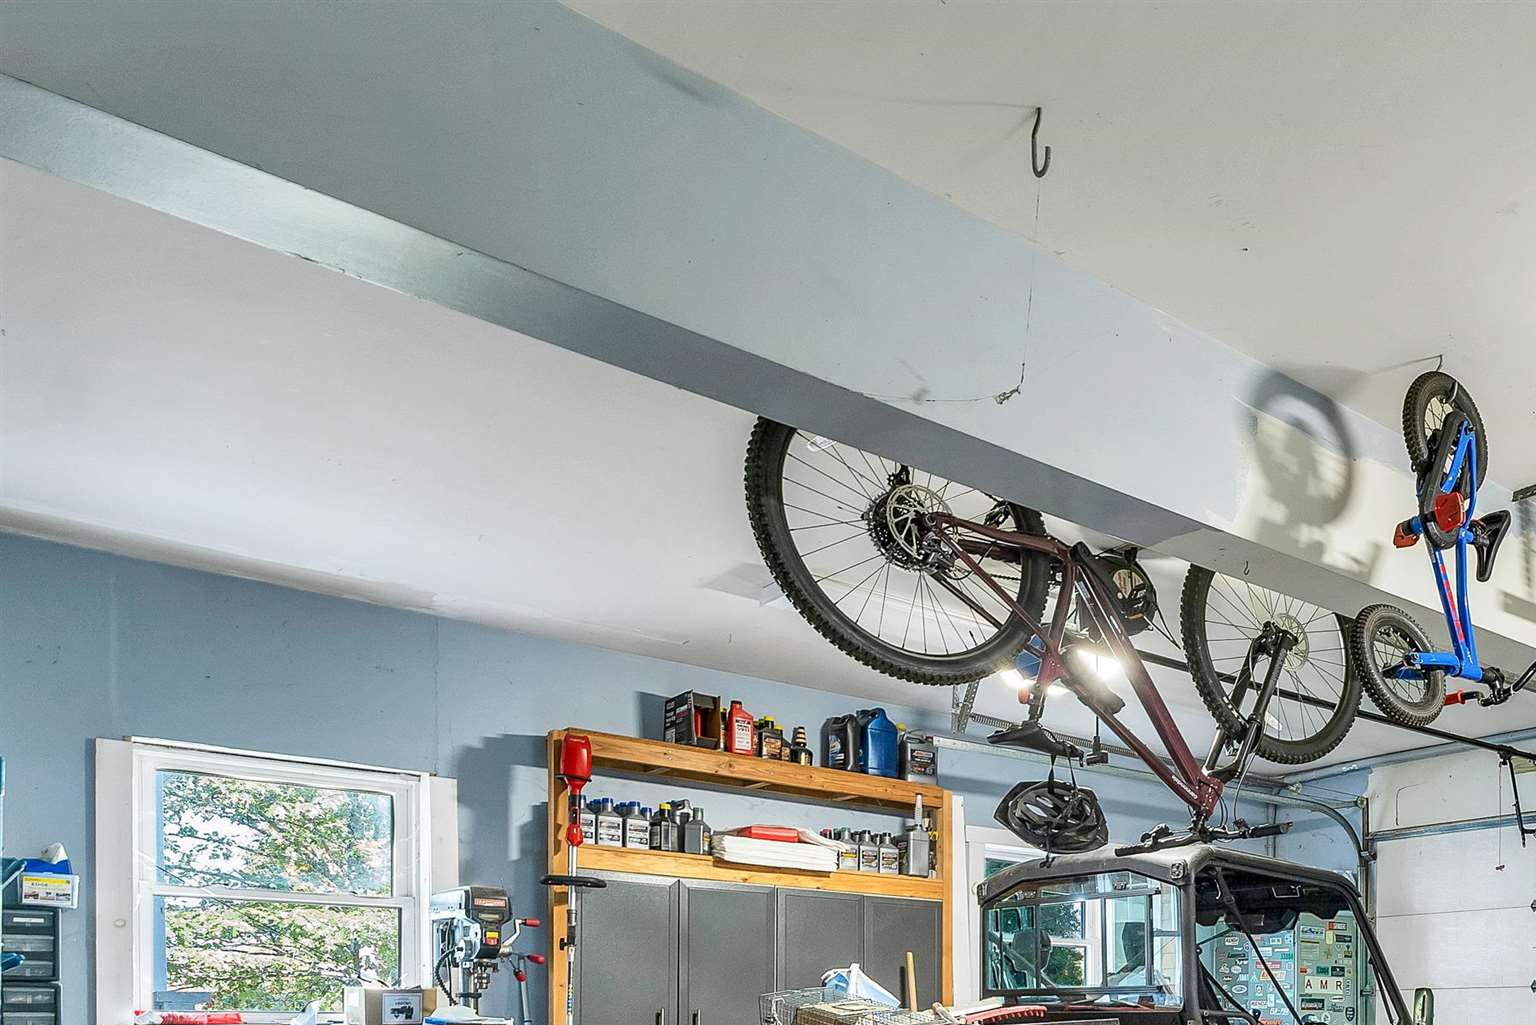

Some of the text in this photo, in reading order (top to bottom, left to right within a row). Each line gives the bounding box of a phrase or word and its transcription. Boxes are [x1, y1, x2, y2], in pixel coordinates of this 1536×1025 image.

[1305, 978, 1343, 991] A M R
